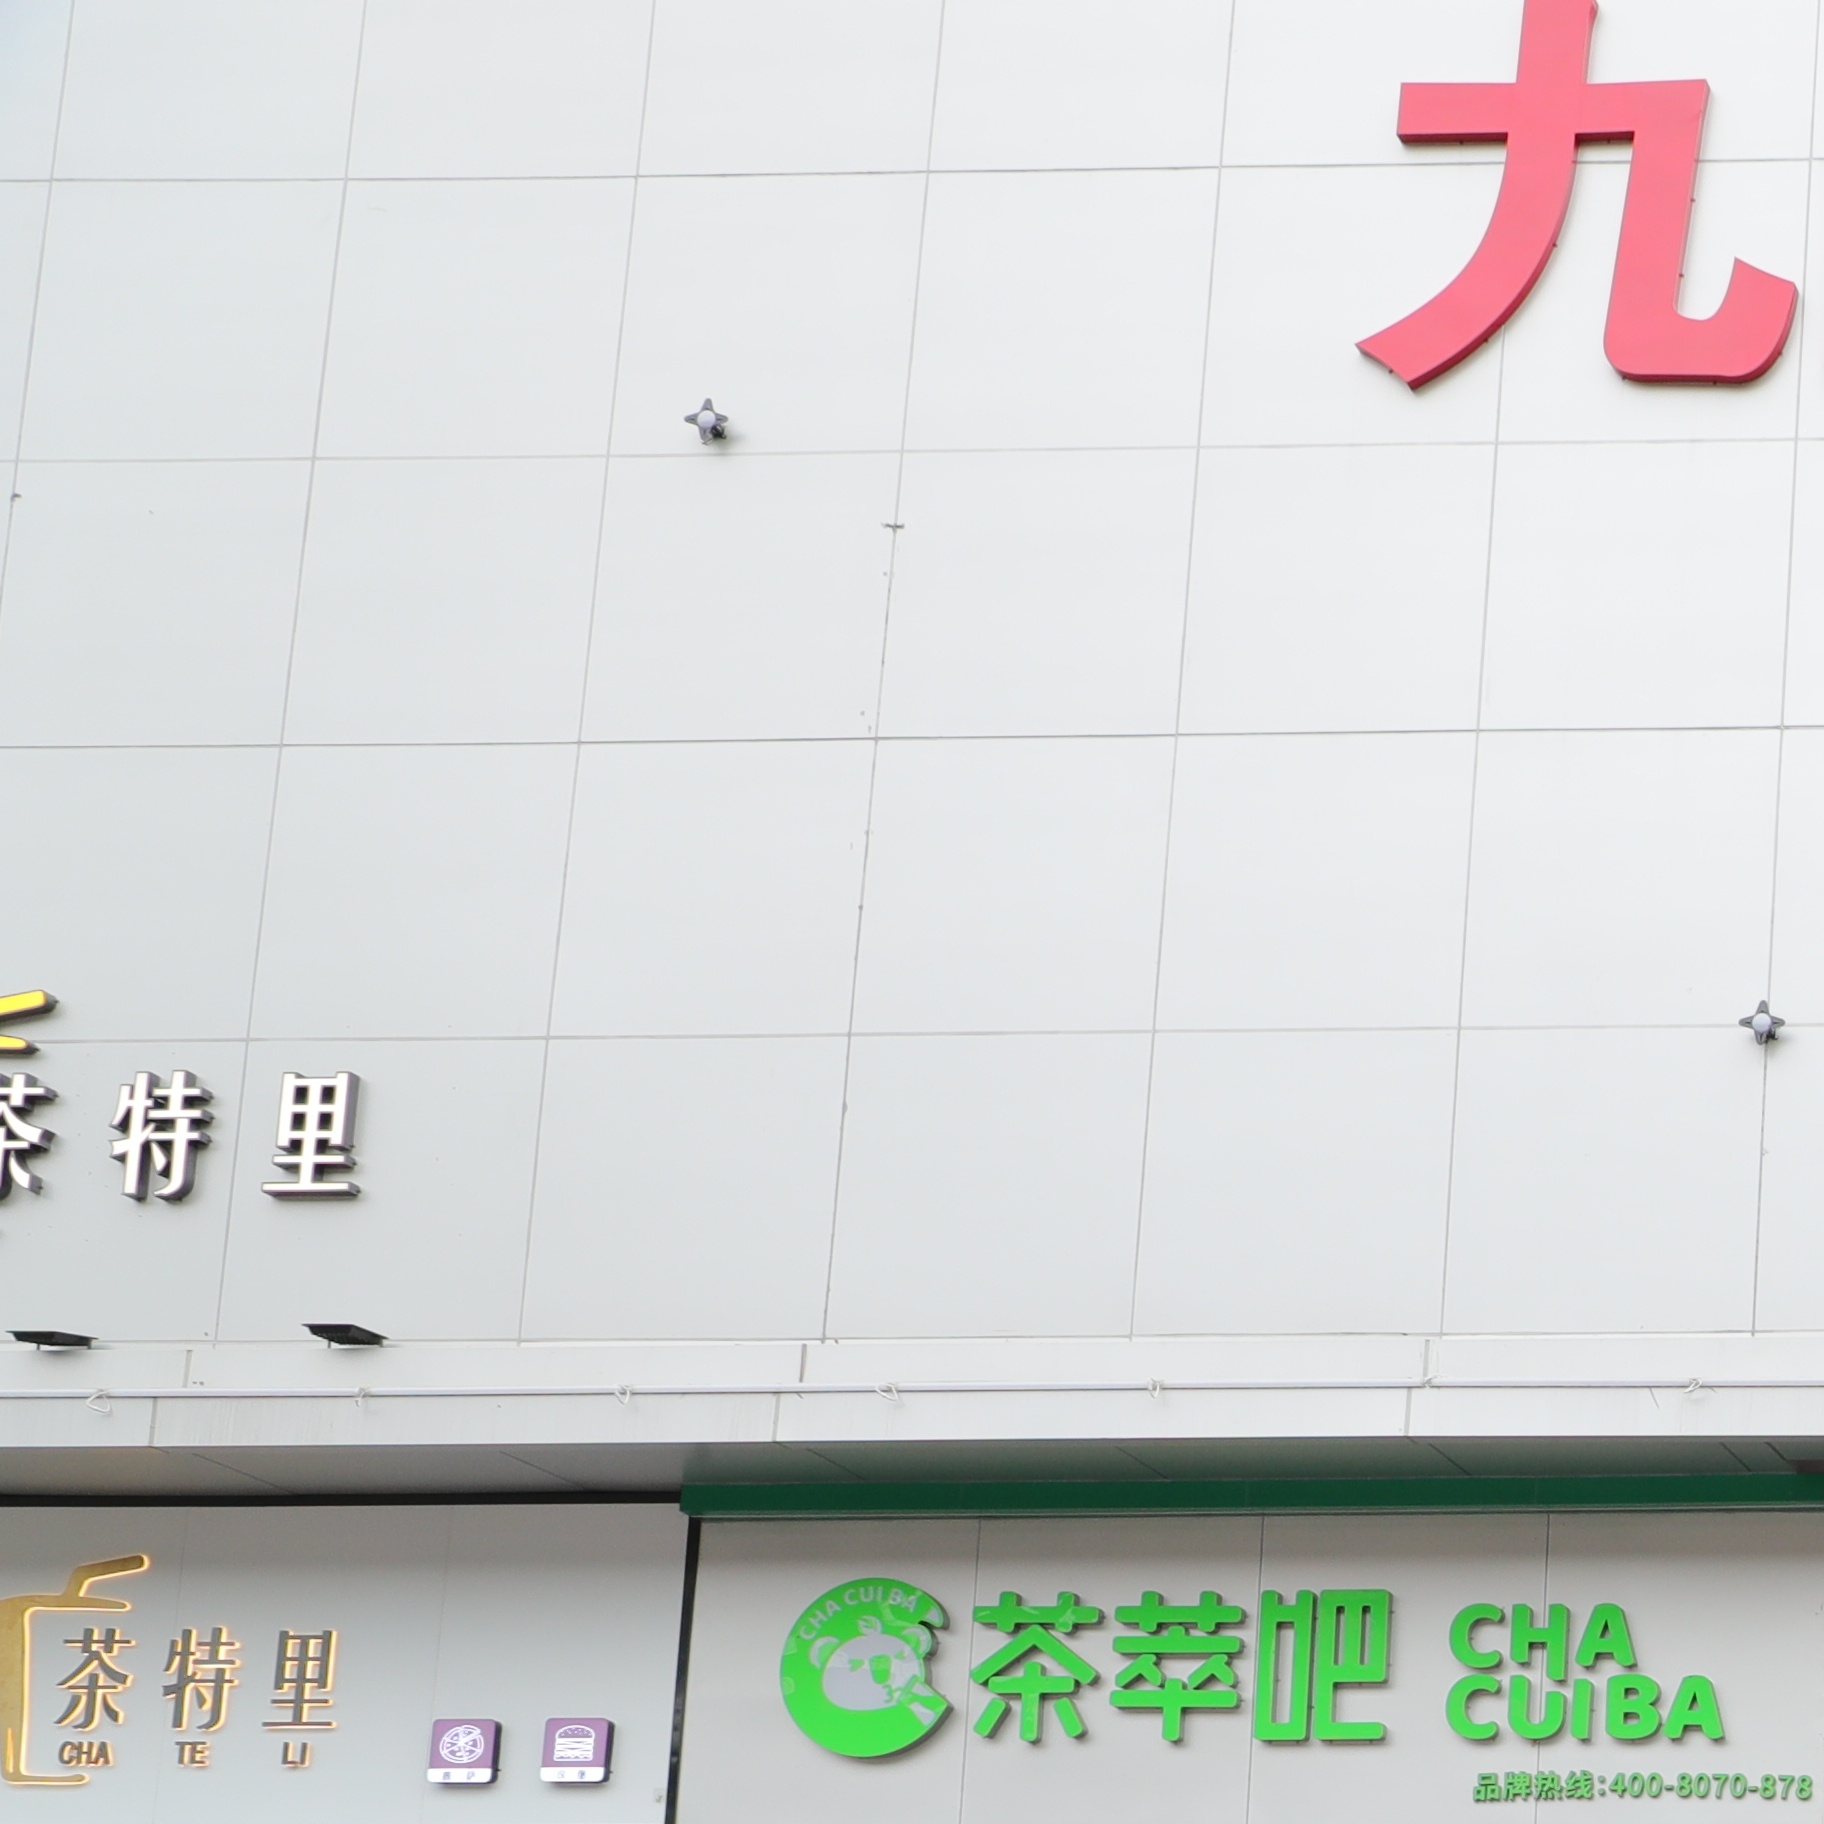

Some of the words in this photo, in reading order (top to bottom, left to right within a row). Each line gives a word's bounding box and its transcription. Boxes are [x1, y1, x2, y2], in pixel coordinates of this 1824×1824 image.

[800, 1600, 841, 1640] CHA
[844, 1587, 883, 1606] CUI
[889, 1589, 918, 1612] BA
[1449, 1601, 1639, 1680] CHA
[54, 1626, 337, 1731] 茶特里
[969, 1589, 1394, 1743] 茶萃吧
[1445, 1673, 1726, 1743] CUIBA
[57, 1740, 113, 1767] CHA
[174, 1740, 210, 1767] TE
[281, 1740, 310, 1767] LI
